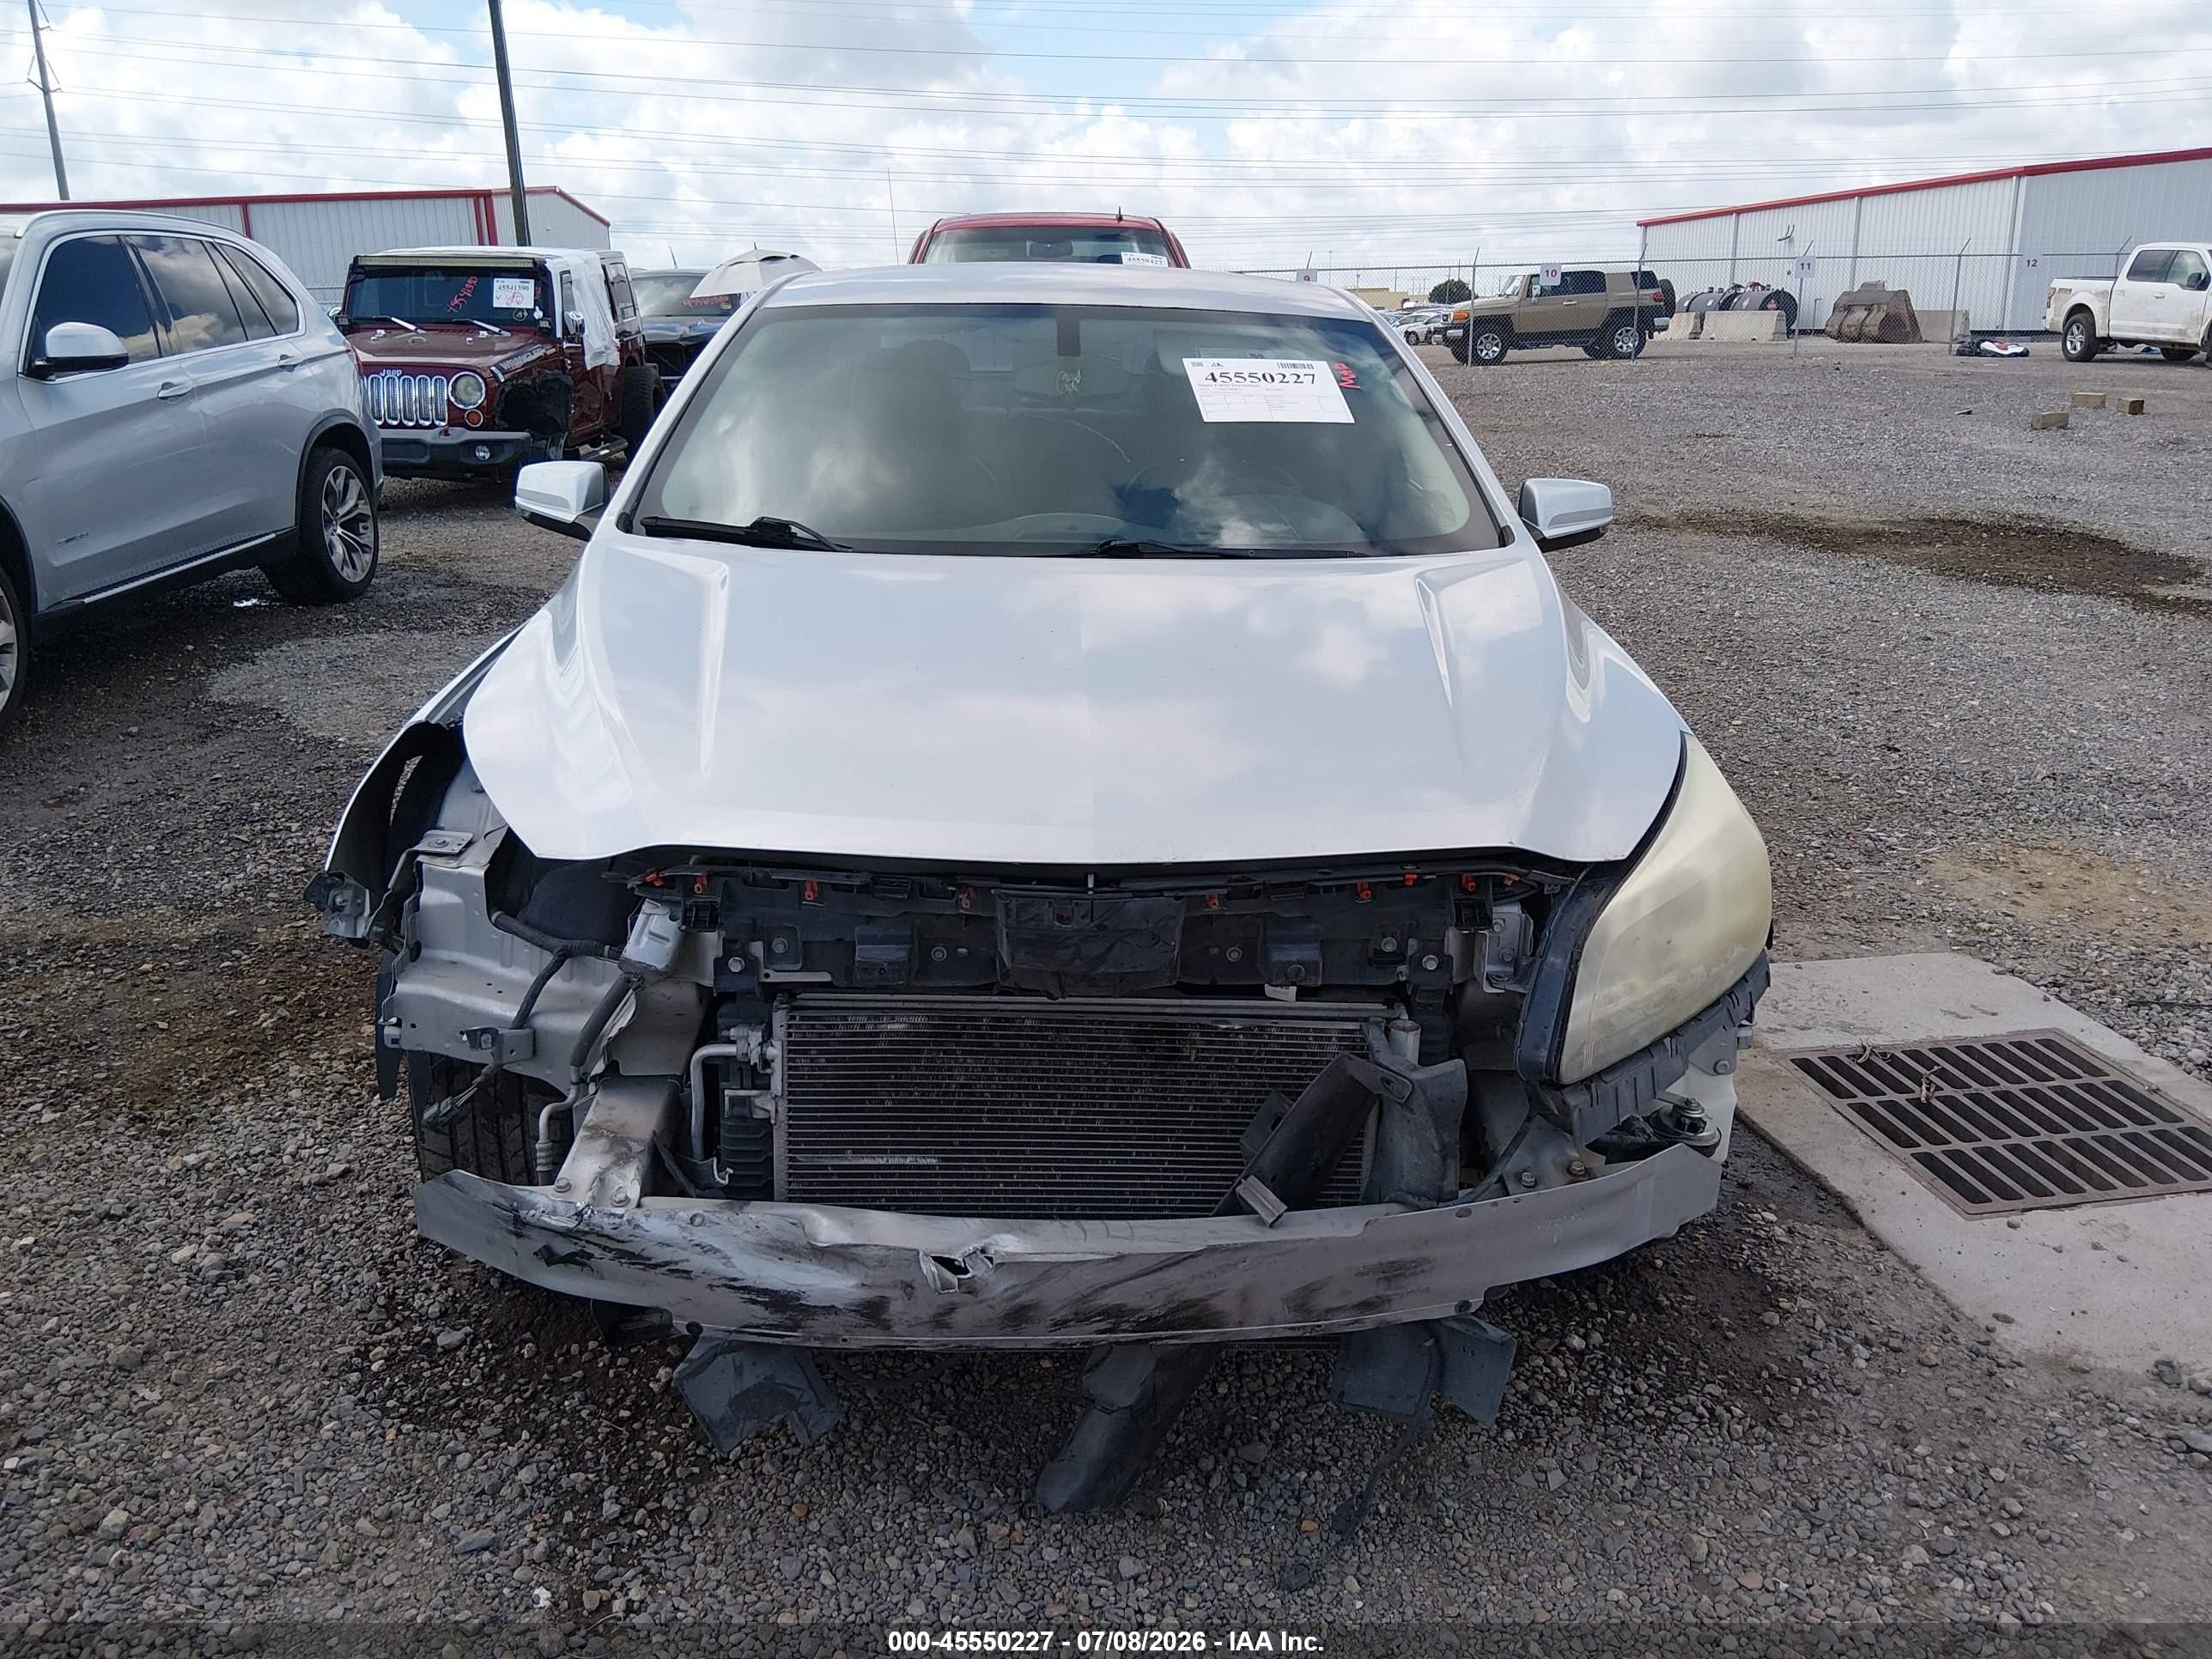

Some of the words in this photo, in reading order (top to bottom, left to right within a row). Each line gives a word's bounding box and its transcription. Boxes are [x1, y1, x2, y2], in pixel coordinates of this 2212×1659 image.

[1800, 262, 1811, 270] 11
[2027, 258, 2038, 268] 12
[1545, 269, 1558, 278] 10
[380, 368, 403, 377] Jeep
[1204, 371, 1316, 385] 45550227
